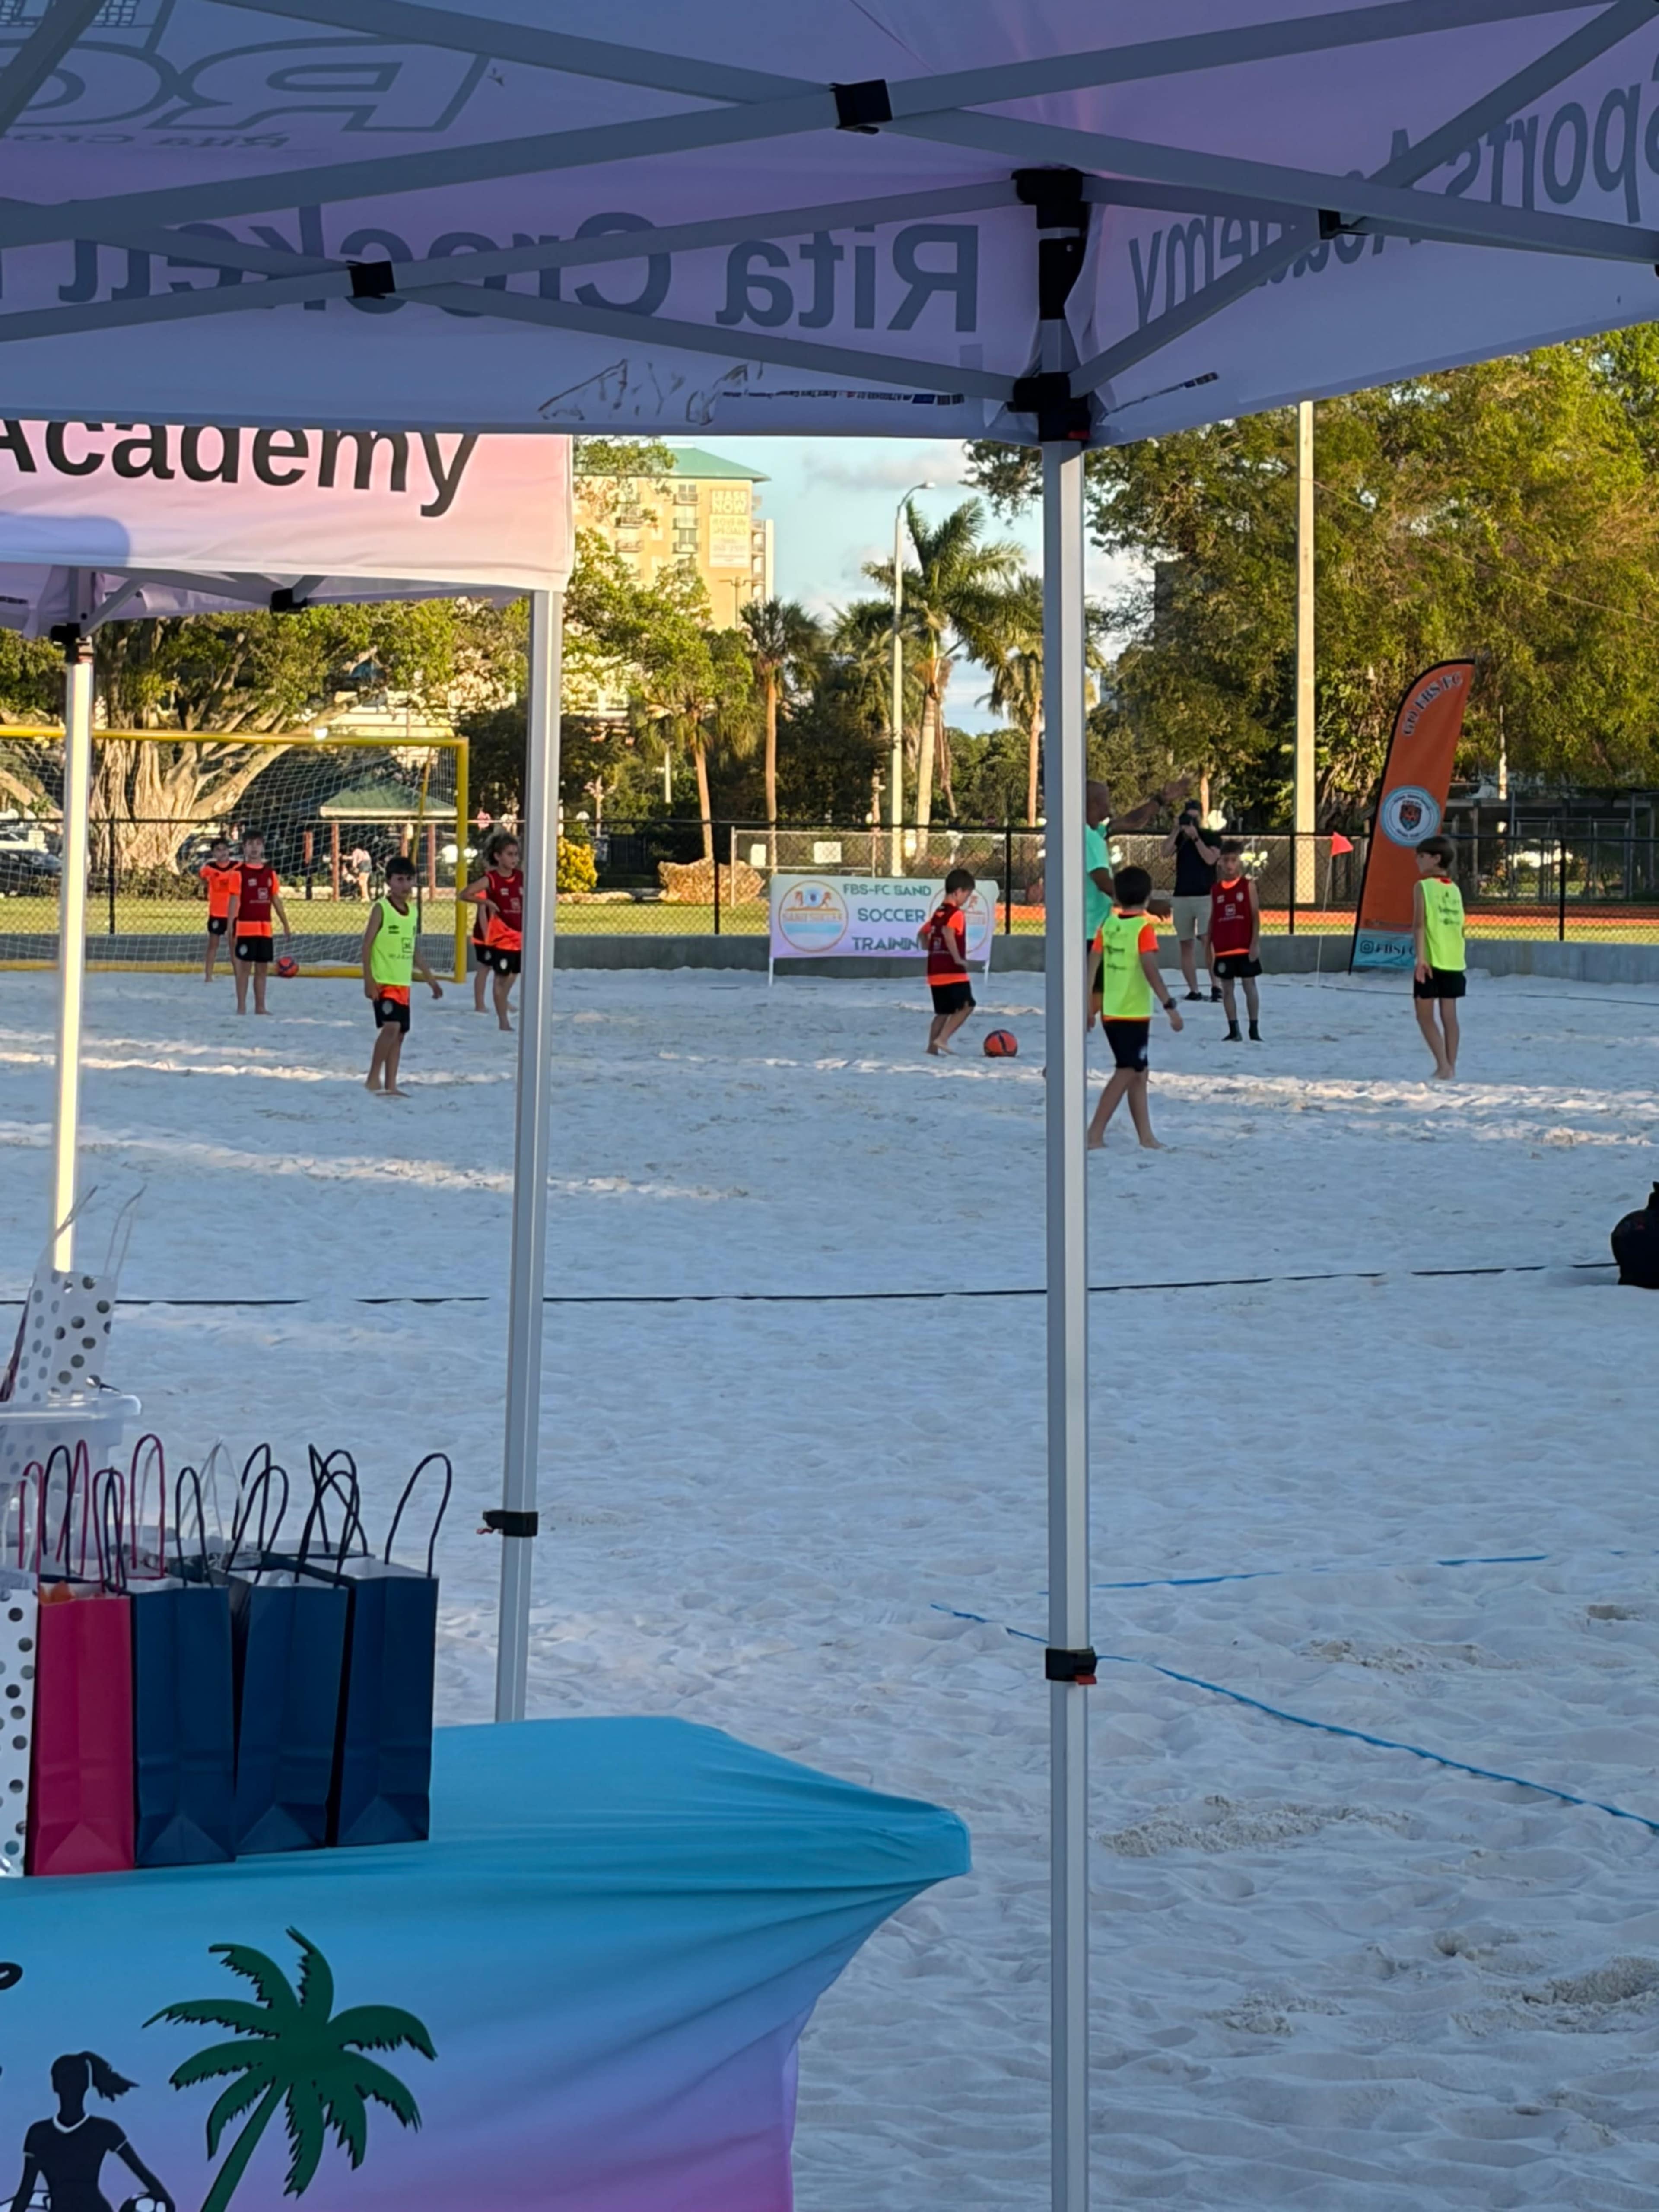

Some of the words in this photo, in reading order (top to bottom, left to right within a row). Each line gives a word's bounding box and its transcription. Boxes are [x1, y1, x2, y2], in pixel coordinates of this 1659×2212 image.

[712, 490, 747, 500] LEASE
[712, 500, 747, 514] NOW
[843, 884, 890, 895] FBS-FC
[893, 884, 932, 896] SAND
[858, 908, 926, 922] SOCCER
[851, 936, 919, 951] TRAININ
